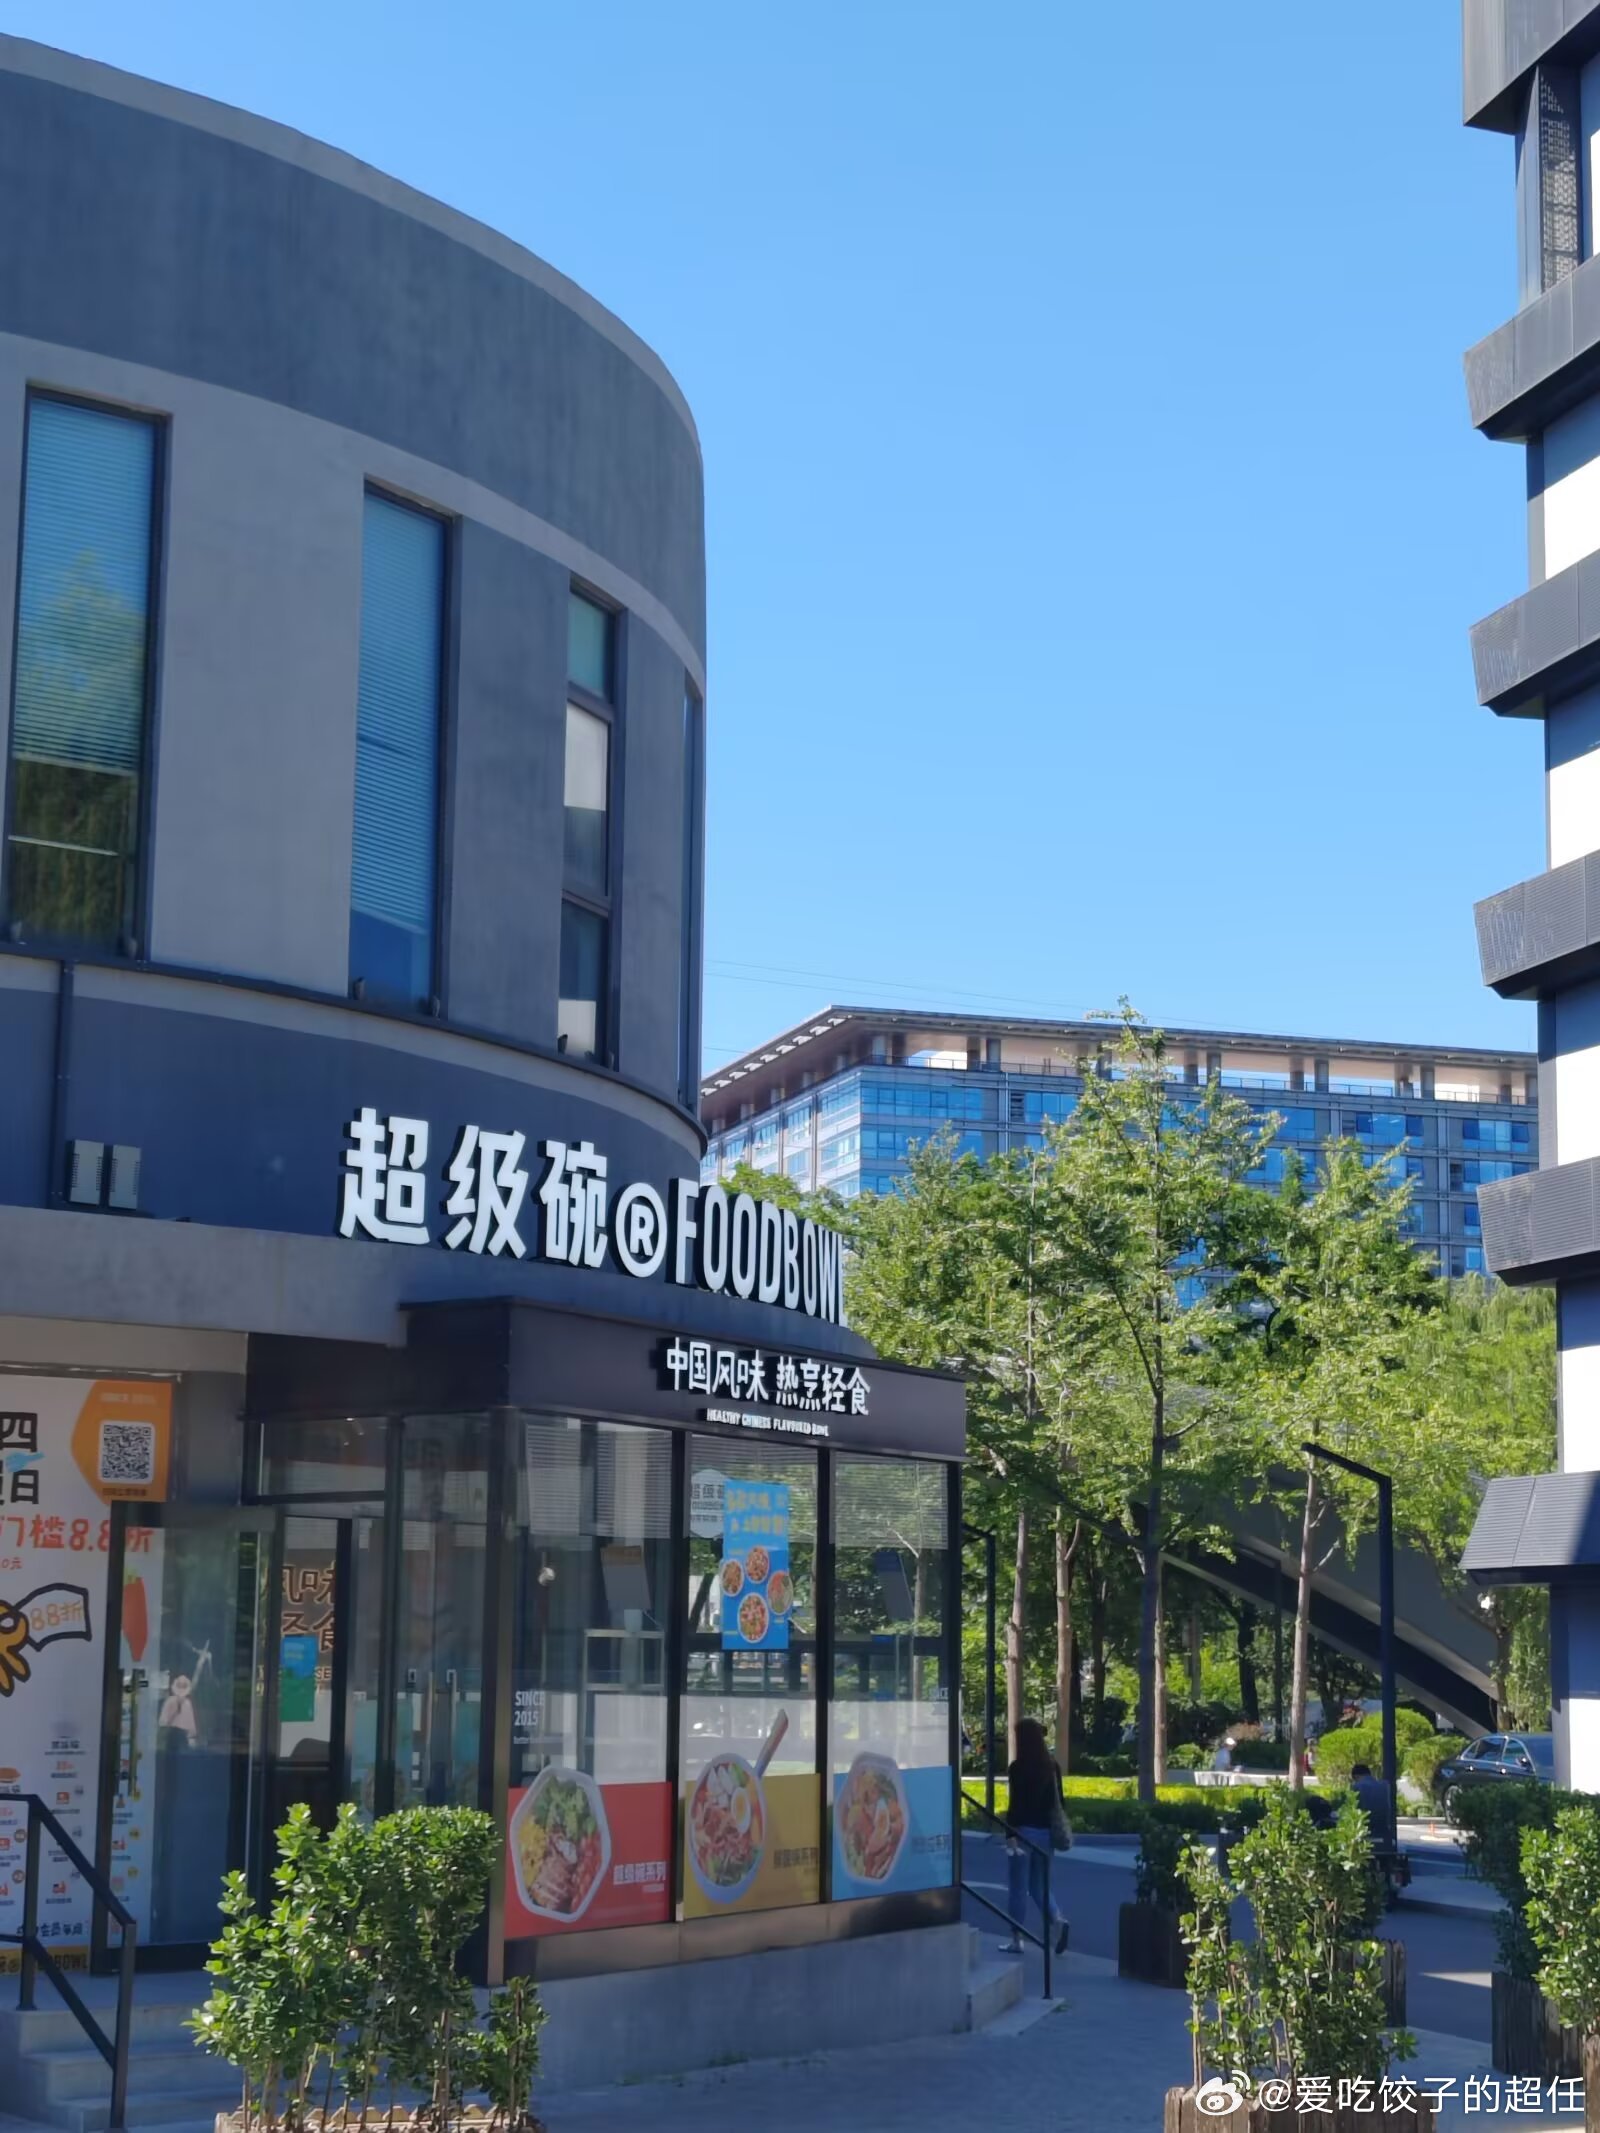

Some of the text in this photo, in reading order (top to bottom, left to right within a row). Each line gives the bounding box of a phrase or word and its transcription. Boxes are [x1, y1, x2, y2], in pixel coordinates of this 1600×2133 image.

[340, 1107, 607, 1268] 超级碗
[675, 1178, 849, 1328] FOODBOWL
[666, 1336, 871, 1416] 中国风味 热烹轻食
[706, 1408, 740, 1426] HEALTHY
[741, 1413, 771, 1430] CHINESE
[514, 1710, 539, 1726] 2015
